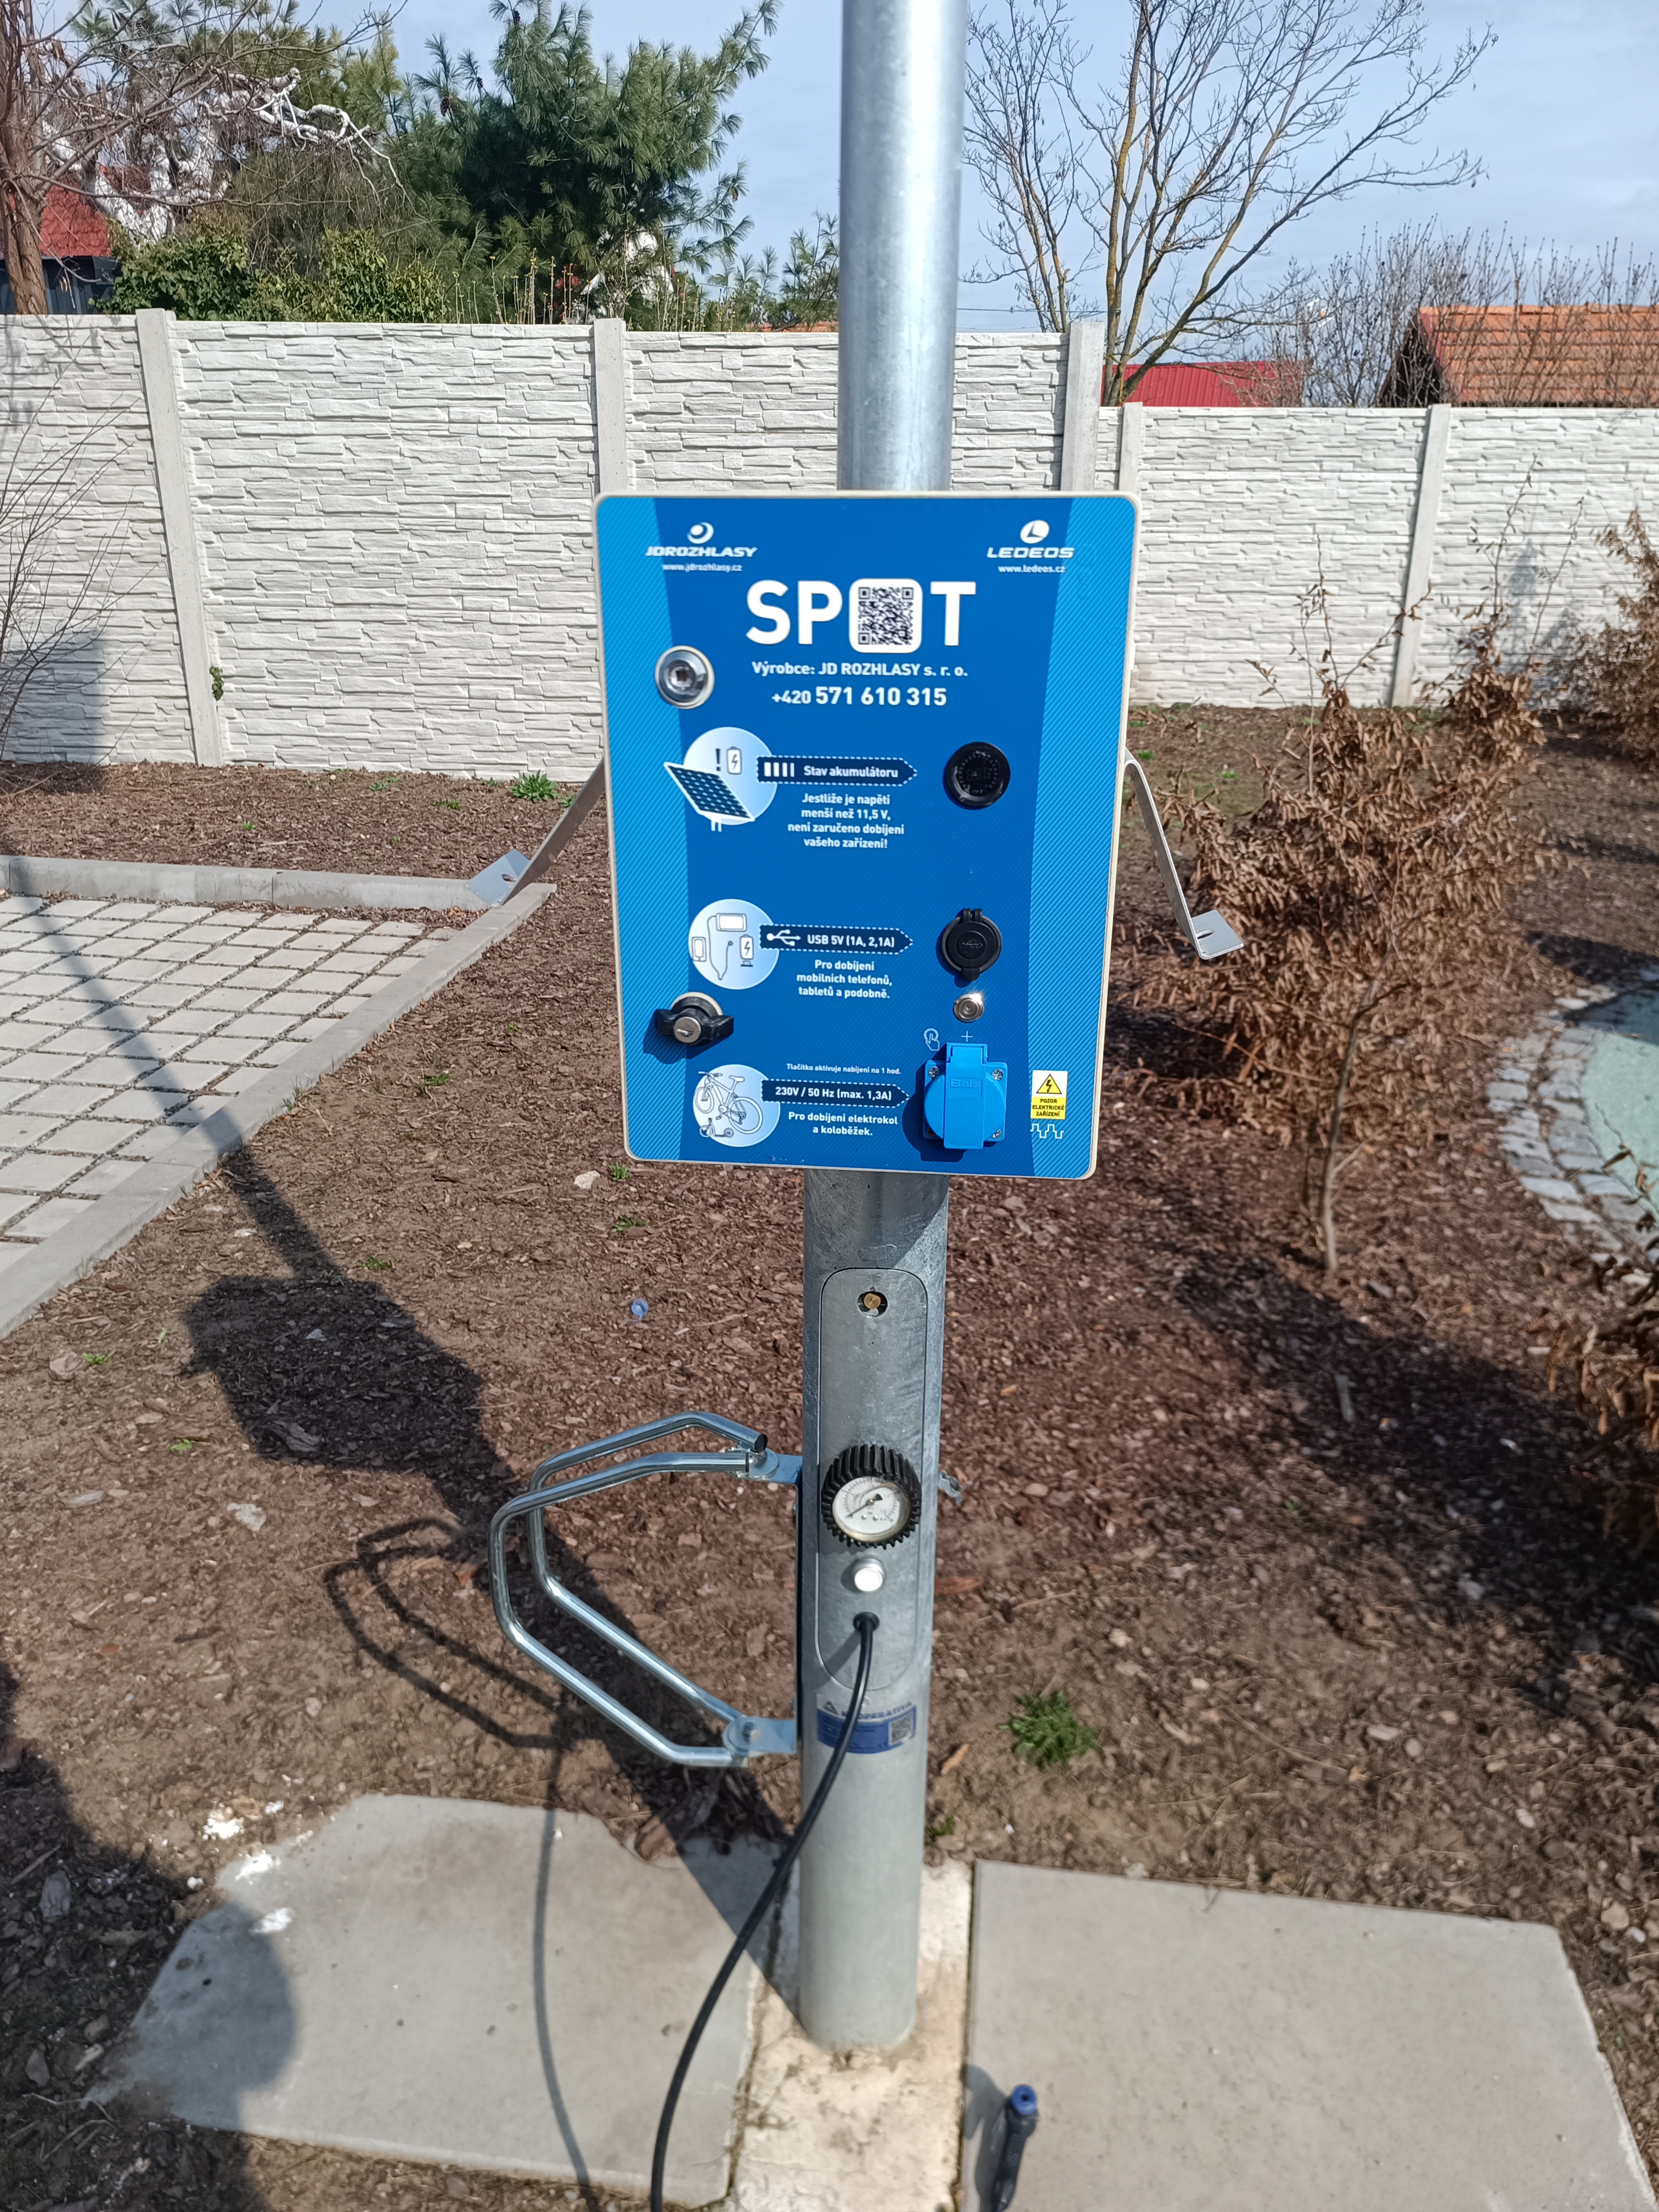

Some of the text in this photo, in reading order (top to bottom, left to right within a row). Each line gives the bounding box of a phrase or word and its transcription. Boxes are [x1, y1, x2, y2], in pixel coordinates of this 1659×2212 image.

[986, 546, 1075, 558] LEDEOS
[661, 562, 743, 573] www.jdrozhlasy.cz
[997, 564, 1066, 573] www.ledeos.cz
[752, 660, 968, 676] Výrobce: JD ROZHLASY s. r. o.
[771, 686, 947, 706] +420 571 610 315
[803, 765, 898, 777] Stav akumulátoru
[802, 793, 890, 806] Jestliže je napětí
[801, 808, 890, 821] menší než 11,5 V,
[787, 821, 905, 836] není zaručeno dobíjení
[803, 837, 888, 848] vašeho zařízení!
[807, 934, 895, 948] USB 5V (1A, 2,1A)
[815, 960, 874, 972] Pro dobíjení
[797, 973, 892, 986] mobilních telefonů,
[798, 986, 833, 996] tabletů
[844, 989, 890, 999] podobně.
[815, 1064, 842, 1073] aktivuje
[843, 1065, 870, 1074] nabíjení
[950, 1079, 980, 1088] Bals
[775, 1086, 891, 1101] 230V / 50 Hz (max. 1,3A)
[788, 1111, 898, 1125] Pro dobíjení elektrokol
[821, 1125, 873, 1136] koloběžek.
[840, 1700, 913, 1719] KOPERATIVA
